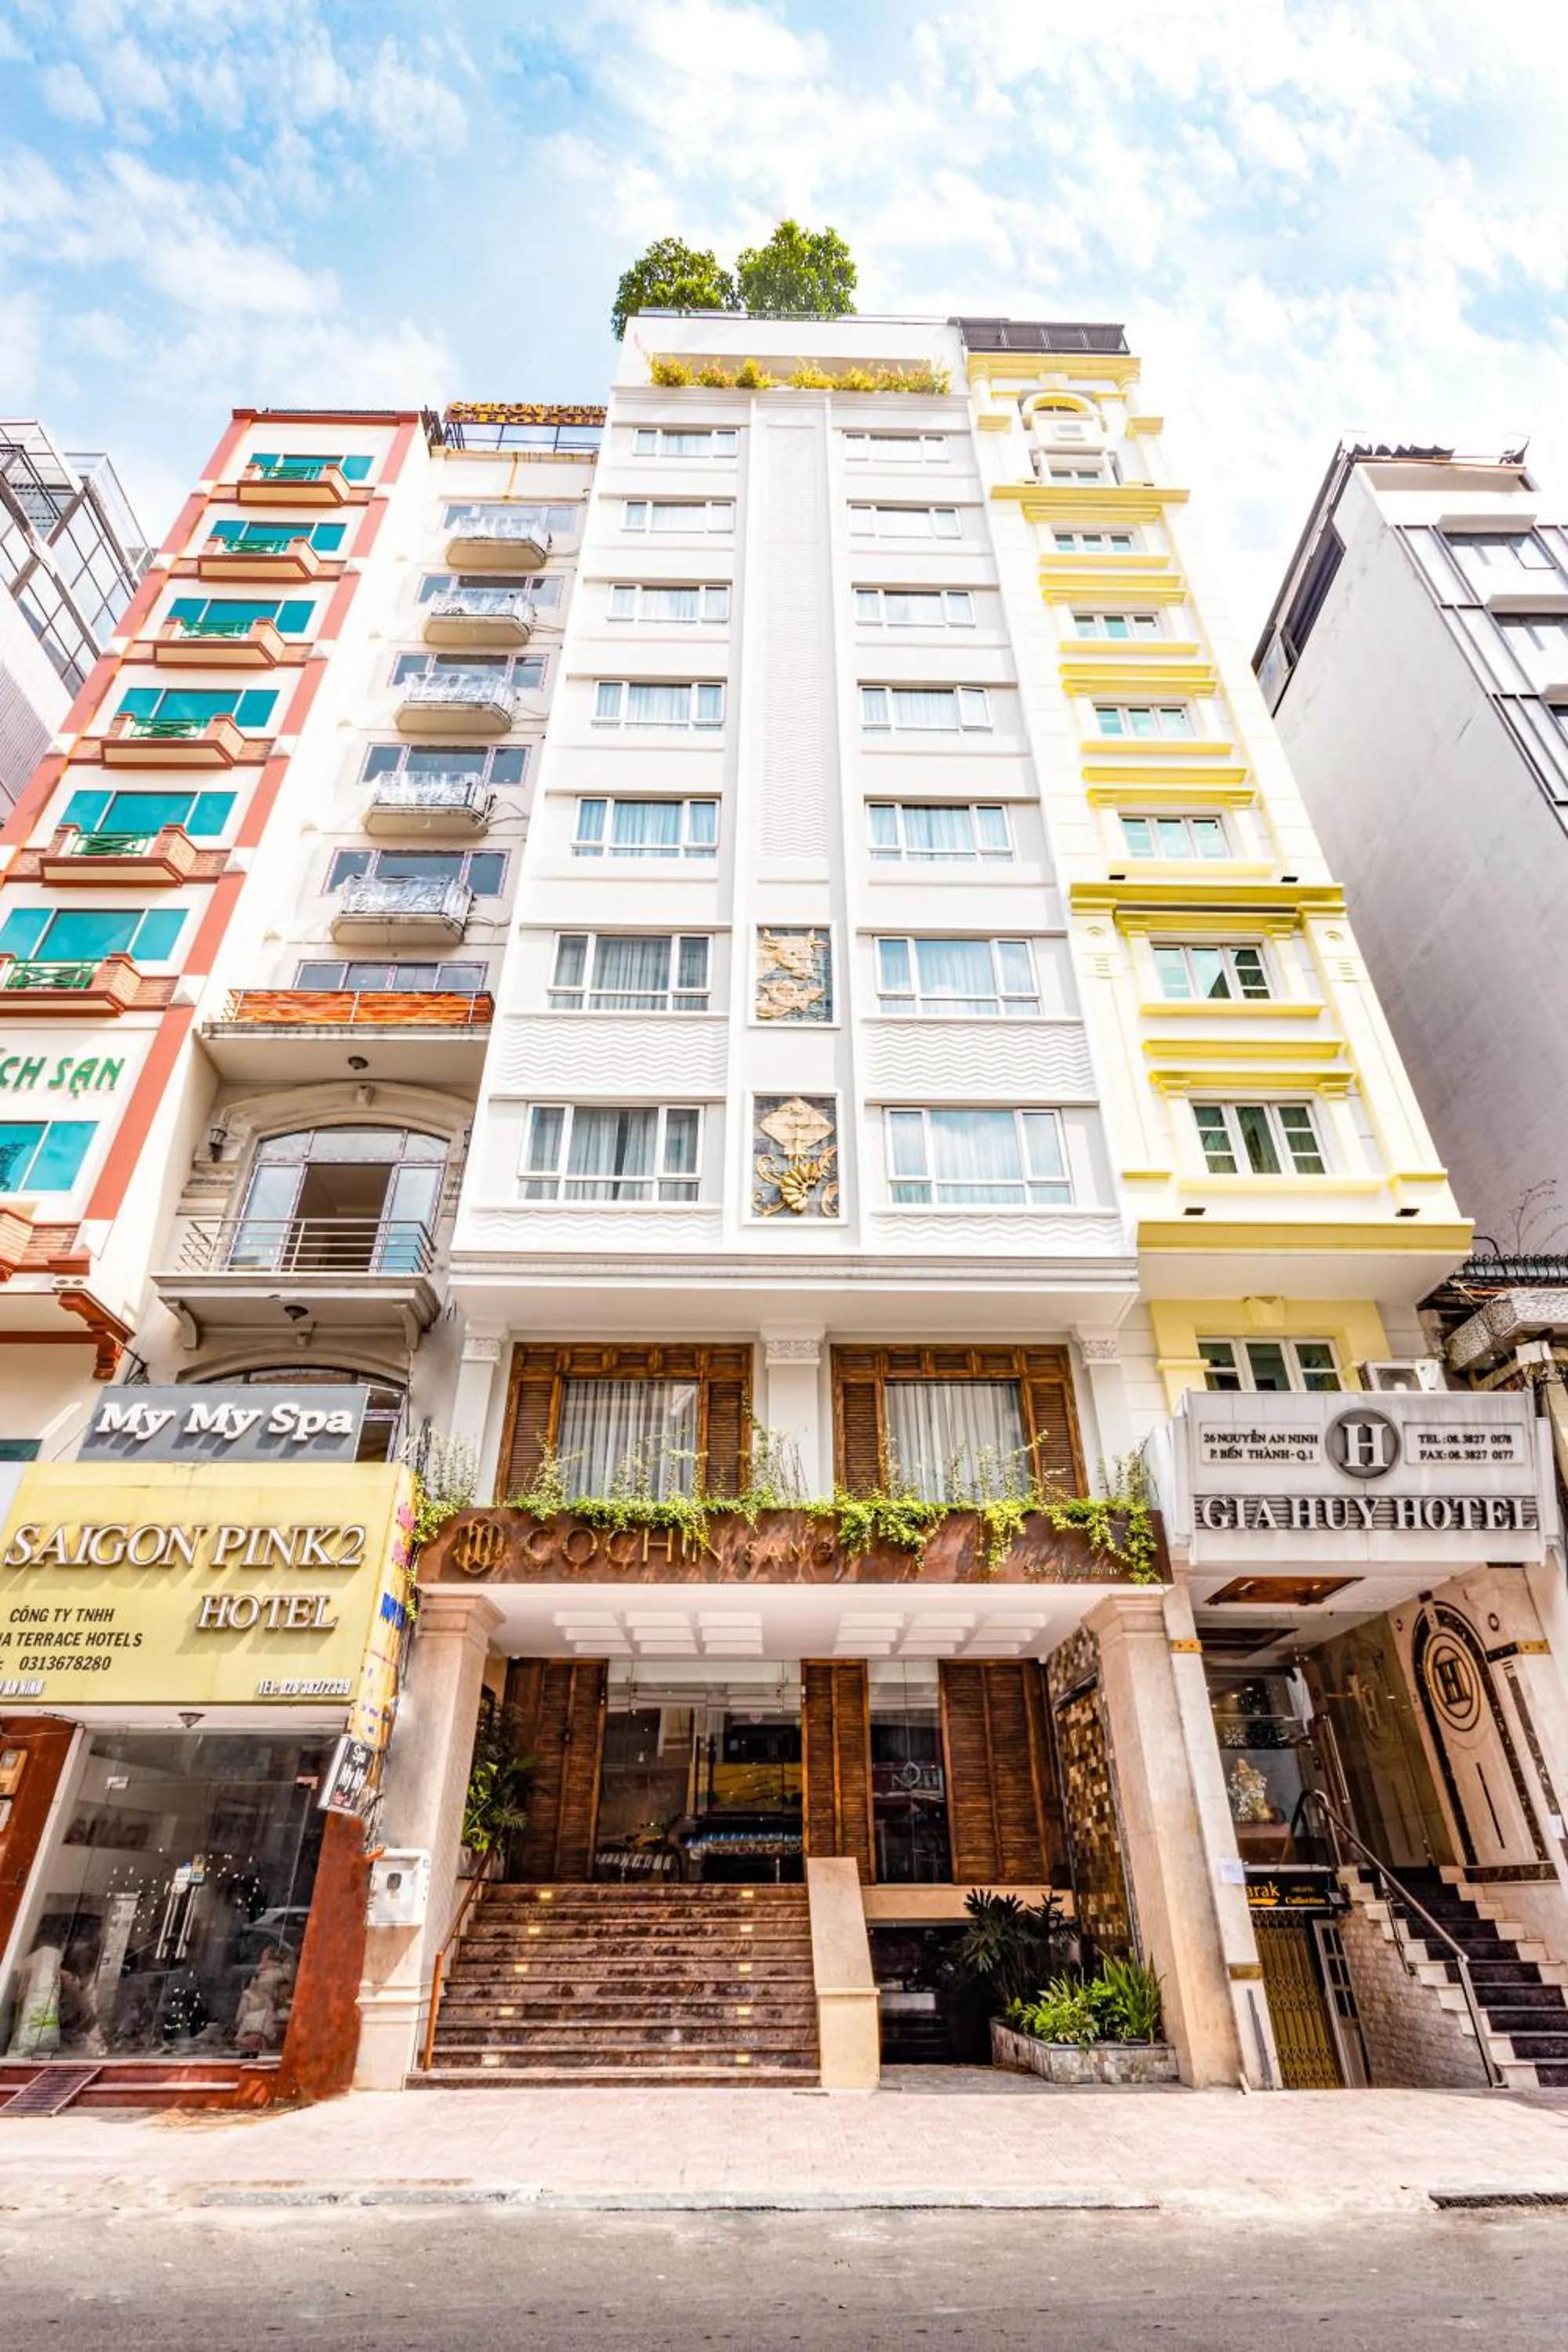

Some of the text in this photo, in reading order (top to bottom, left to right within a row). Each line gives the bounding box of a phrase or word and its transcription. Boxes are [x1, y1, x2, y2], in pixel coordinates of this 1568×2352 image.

[48, 1057, 125, 1098] SẠN
[94, 1401, 354, 1441] My My Spa
[1203, 1433, 1215, 1443] 26
[1269, 1434, 1286, 1443] AN
[1288, 1434, 1318, 1443] NINH
[1343, 1423, 1389, 1467] H
[1202, 1496, 1537, 1530] GIA HUY HOTEL
[3, 1523, 205, 1567] SAIGON
[9, 1606, 115, 1623] CÔNG TY TNHH
[195, 1594, 339, 1630] HOTEL
[16, 1632, 82, 1647] TERRACE
[85, 1632, 143, 1647] HOTELS
[19, 1656, 112, 1671] 0313678280
